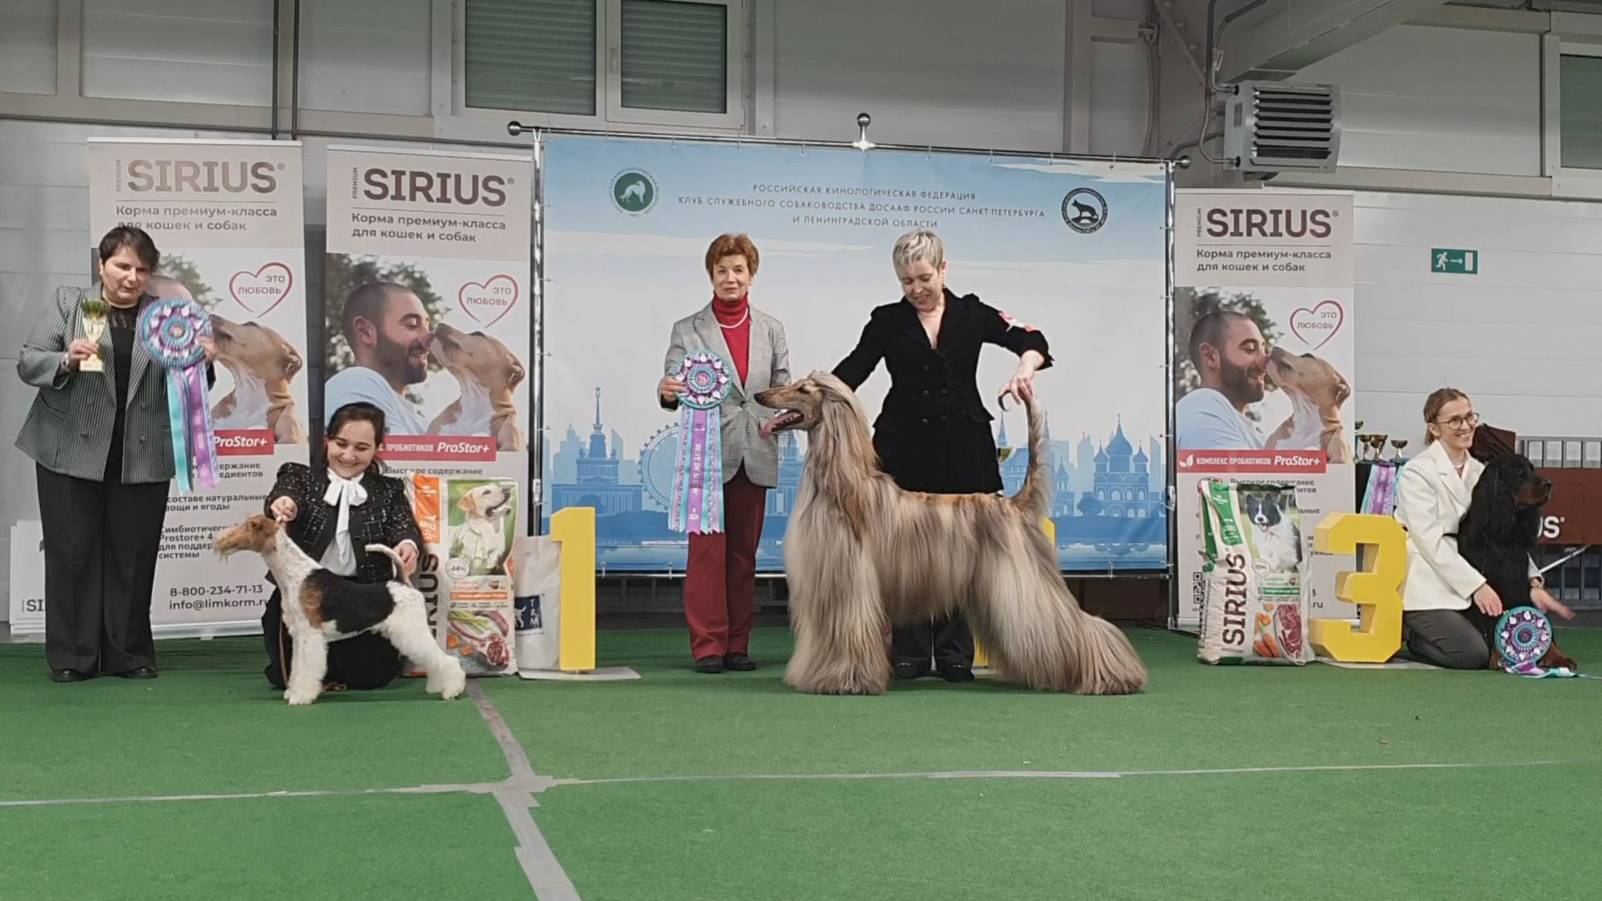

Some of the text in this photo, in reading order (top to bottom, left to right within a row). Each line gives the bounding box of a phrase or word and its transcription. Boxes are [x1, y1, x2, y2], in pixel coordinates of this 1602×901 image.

[127, 159, 277, 194] SIRIUS
[363, 168, 506, 207] SIRIUS
[753, 184, 976, 200] РОССИЙСКАЯ КИНОЛОГИЧЕСКАЯ ФЕДЕРАЦИЯ
[116, 206, 278, 218] Корма премиум-класса
[678, 196, 1045, 217] КЛУБ СЛУЖЕБНОГО СОБАКОВОДСТВА ДОСААФ РОССИИ САНКТ-ПЕТЕРБУРГА
[146, 221, 190, 230] кошек
[194, 221, 203, 230] и
[207, 220, 247, 231] собак
[352, 213, 506, 230] Корма премиум-класса
[793, 216, 938, 229] И ЛЕНИНГРАДСКОЙ ОБЛАСТИ
[1206, 208, 1332, 238] SIRIUS
[352, 229, 477, 242] для кошек и собак
[1197, 249, 1332, 261] Корма премиум-класса
[1197, 264, 1219, 272] для
[1272, 262, 1306, 272] собак
[265, 275, 286, 283] ЭТО
[237, 286, 282, 295] ЛЮБОВЬ
[493, 287, 512, 295] ЭТО
[466, 297, 508, 306] ЛЮБОВЬ
[1297, 322, 1334, 330] ЛЮБОВЬ
[213, 435, 268, 448] ProStor+
[437, 442, 489, 454] ProStor+
[1274, 455, 1320, 466] ProStor+
[386, 466, 483, 476] Высое содержание
[166, 504, 191, 512] вощи
[200, 503, 230, 511] ягоды
[161, 525, 225, 533] имбиотиче
[178, 543, 213, 551] поддер
[158, 552, 200, 560] системы
[169, 584, 264, 597] 8-800-234-71-13
[551, 506, 596, 672] 1
[1309, 512, 1408, 663] 3
[417, 553, 439, 640] RIUS
[1222, 553, 1247, 646] SIRIUS
